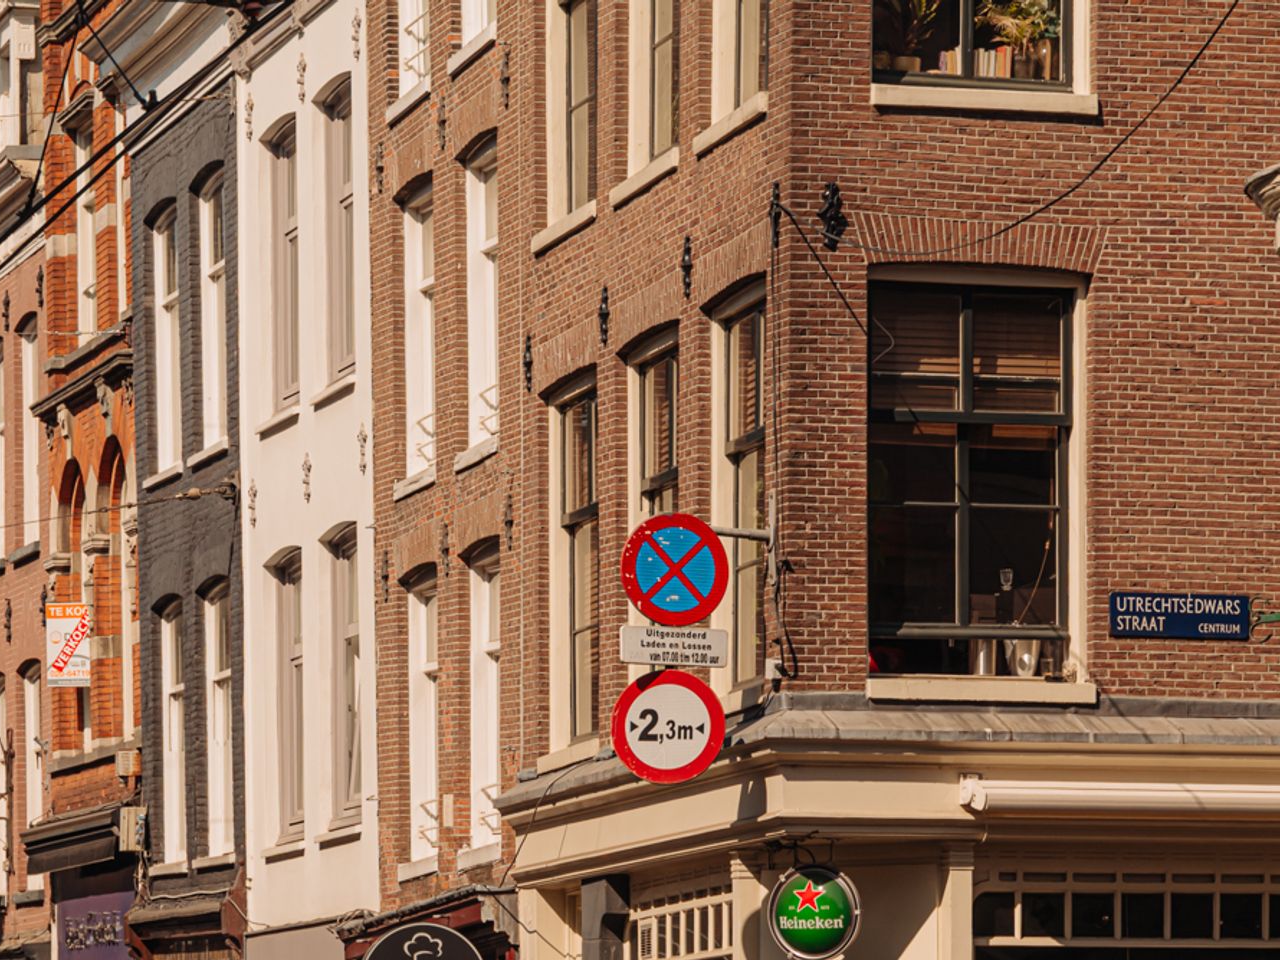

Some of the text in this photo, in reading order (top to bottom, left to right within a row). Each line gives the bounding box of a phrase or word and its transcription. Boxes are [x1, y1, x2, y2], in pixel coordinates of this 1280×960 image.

[49, 607, 63, 617] TE
[1116, 596, 1240, 615] UTRECHTSEDWARS
[1116, 615, 1240, 633] STRAAT CENTRUM
[52, 607, 91, 668] VERKOCH
[646, 628, 707, 640] Uitgezonderd
[640, 640, 666, 649] Laden
[682, 641, 712, 651] Lossen
[649, 653, 661, 661] van
[709, 655, 720, 664] uur
[638, 708, 693, 744] 2,3m
[779, 916, 844, 929] Heineken
